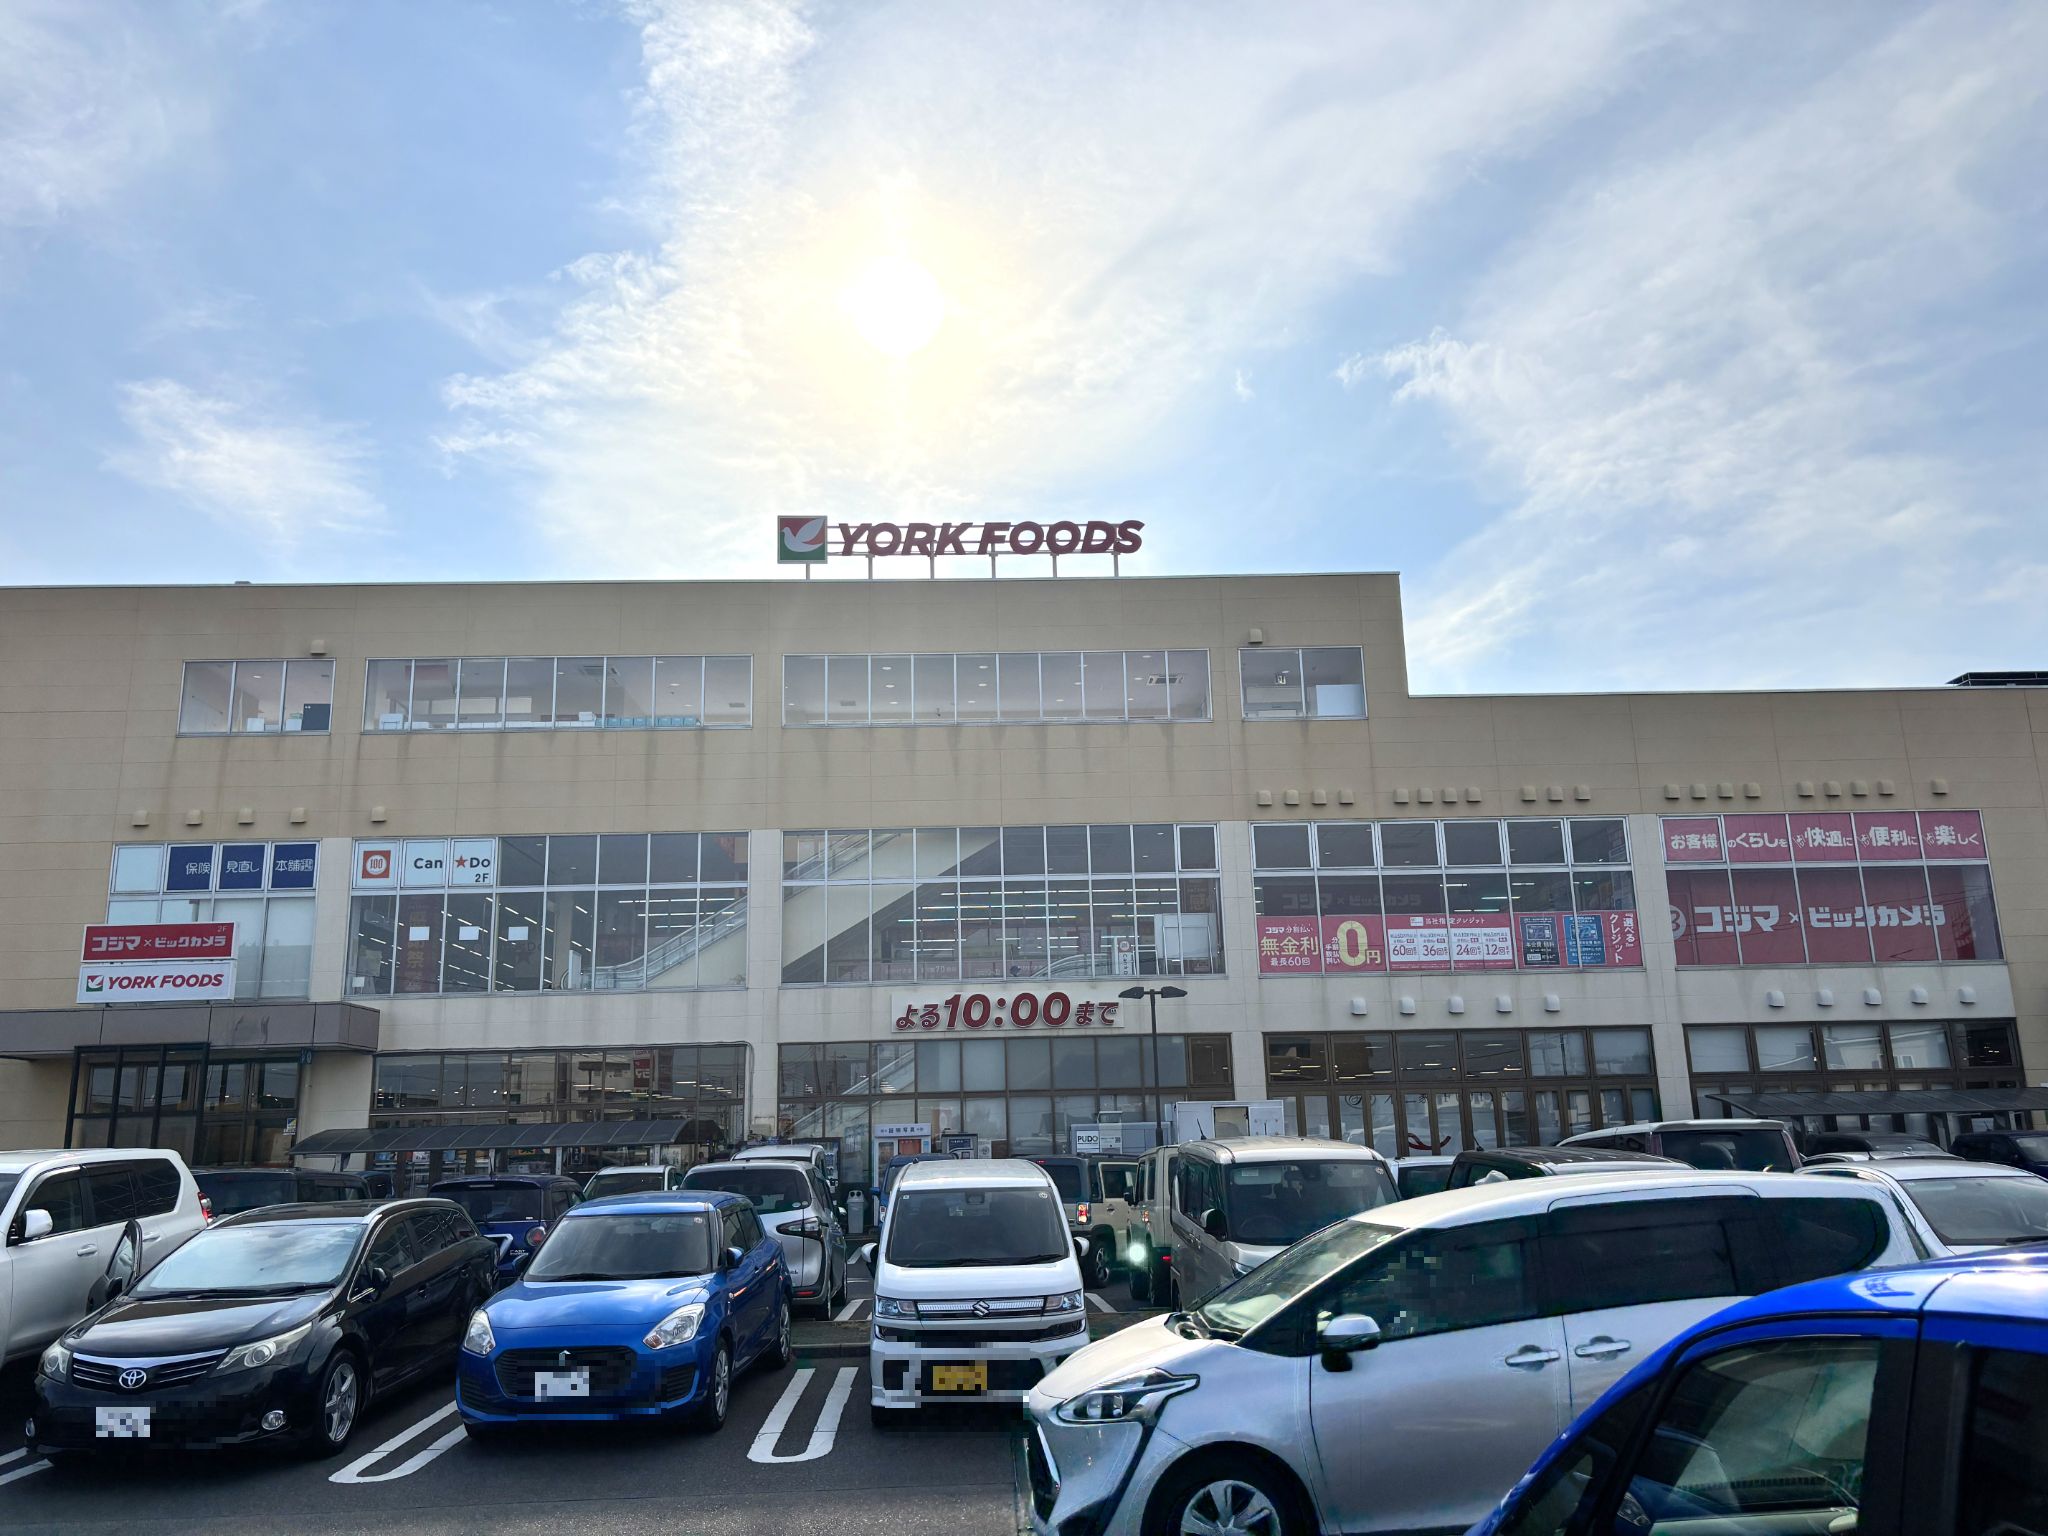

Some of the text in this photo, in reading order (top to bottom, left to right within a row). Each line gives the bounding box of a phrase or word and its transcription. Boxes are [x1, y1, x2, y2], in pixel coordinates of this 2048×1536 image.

[838, 519, 1146, 556] YORK FOODS
[475, 873, 490, 883] 2F
[1260, 936, 1319, 956] 無金利
[1609, 913, 1624, 963] クレジット
[1270, 956, 1311, 966] 最長60回
[107, 973, 225, 990] YORK FOODS
[1077, 1135, 1099, 1143] PUDO
